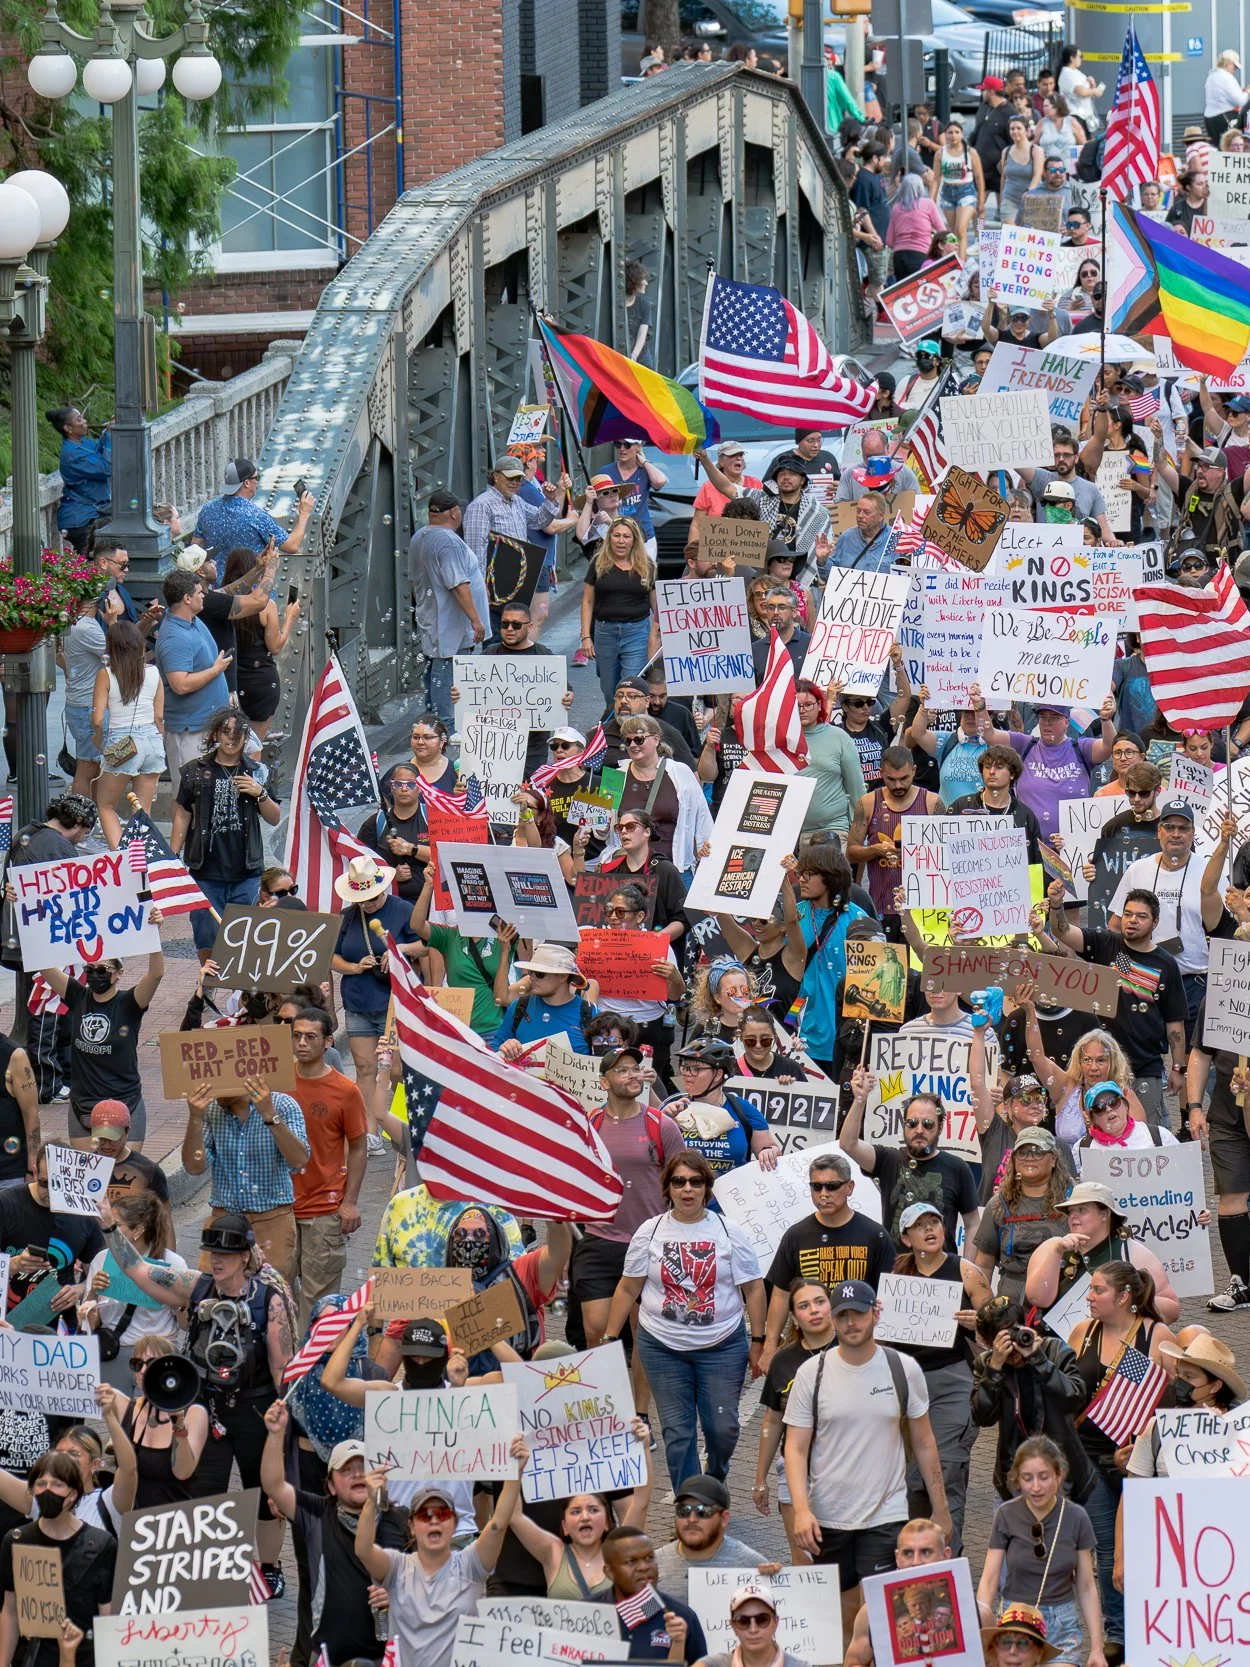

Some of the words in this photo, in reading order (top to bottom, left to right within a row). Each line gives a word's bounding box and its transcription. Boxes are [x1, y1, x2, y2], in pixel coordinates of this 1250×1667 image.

[1211, 172, 1231, 186] THE
[1010, 231, 1054, 246] HUMAN
[1005, 246, 1052, 262] RIGHTS
[1002, 260, 1051, 277] BELONG
[1015, 275, 1029, 284] TO
[661, 581, 731, 605] FIGHT
[1012, 580, 1092, 604] KINGS
[661, 605, 747, 634] IGNORANCE
[690, 630, 721, 649] NOT
[808, 624, 893, 665] DEPORTED
[665, 654, 753, 683] IMMIGRANTS
[1018, 649, 1079, 667] means
[991, 671, 1088, 699] EVERYONE
[743, 820, 771, 828] DISTRESS
[731, 849, 745, 860] ICE
[19, 853, 122, 896] HISTORY
[722, 872, 755, 882] AMERICAN
[70, 886, 100, 910] ITS
[719, 882, 752, 893] GESTAPO
[50, 911, 97, 943] EYES
[109, 905, 144, 935] ON
[224, 916, 326, 977] 99%
[931, 954, 1001, 977] SHAME
[1048, 962, 1099, 996] YOU
[181, 1042, 218, 1062] RED
[236, 1037, 270, 1056] RED
[190, 1060, 223, 1079] HAT
[235, 1056, 278, 1076] COAT
[375, 1393, 496, 1434] CHINGA
[426, 1431, 457, 1447] TU
